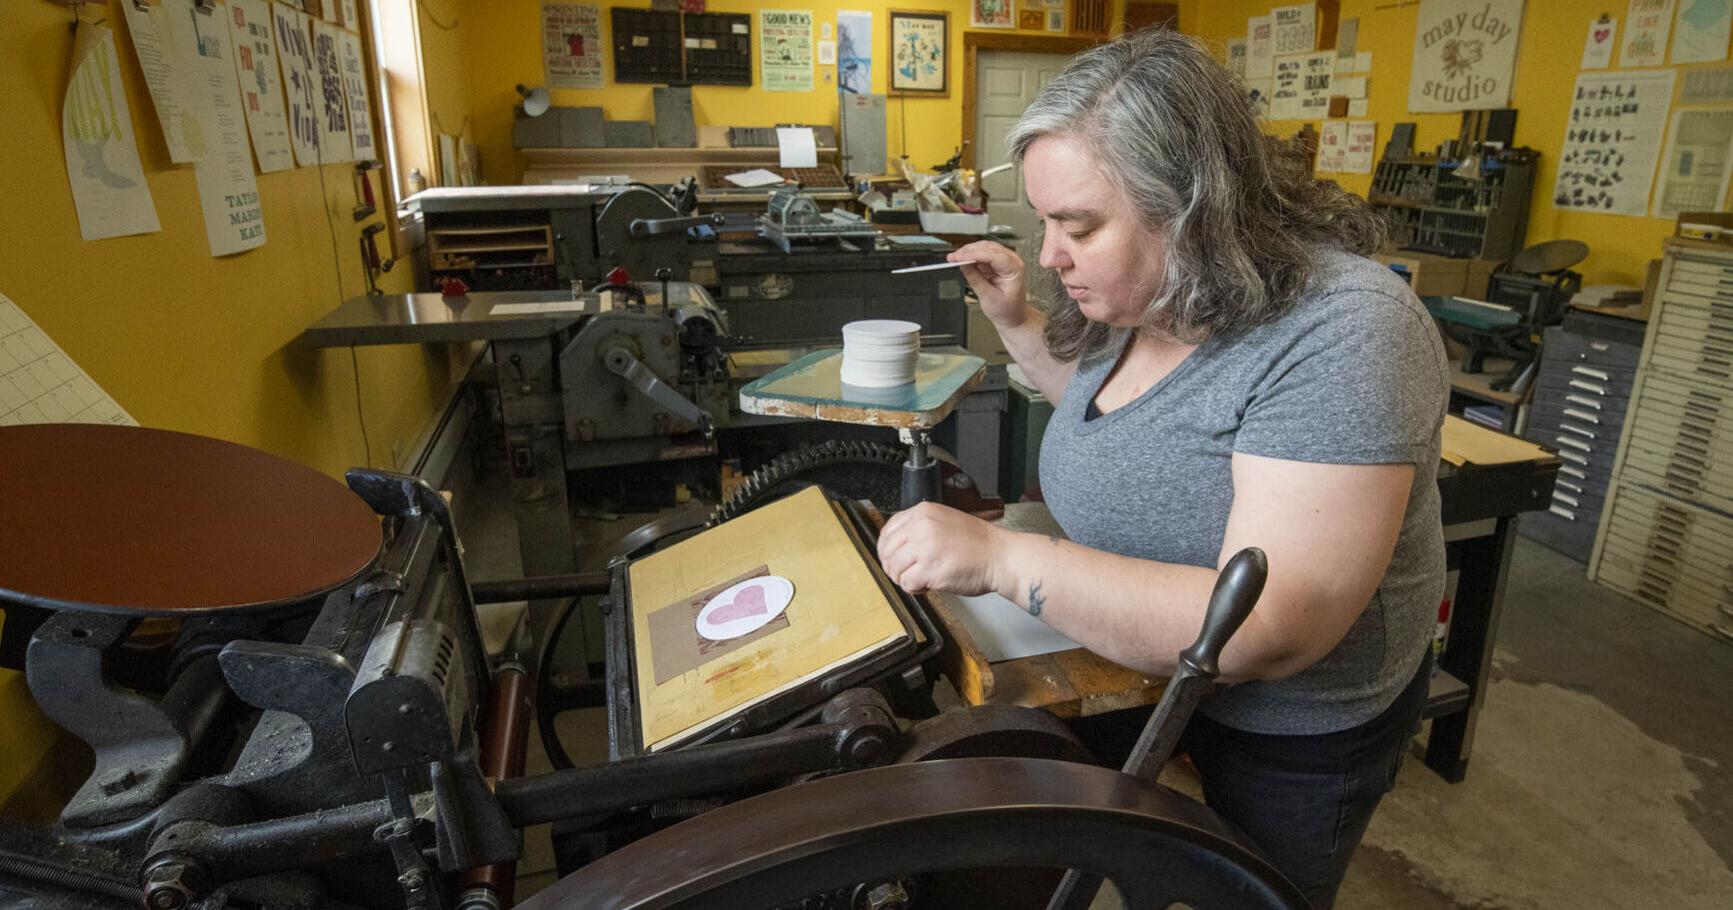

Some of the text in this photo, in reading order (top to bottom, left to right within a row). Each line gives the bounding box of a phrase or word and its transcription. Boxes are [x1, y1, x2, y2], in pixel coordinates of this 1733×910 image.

[767, 13, 811, 25] GOOD NEWS
[1422, 3, 1512, 48] may day
[1422, 75, 1497, 103] studio
